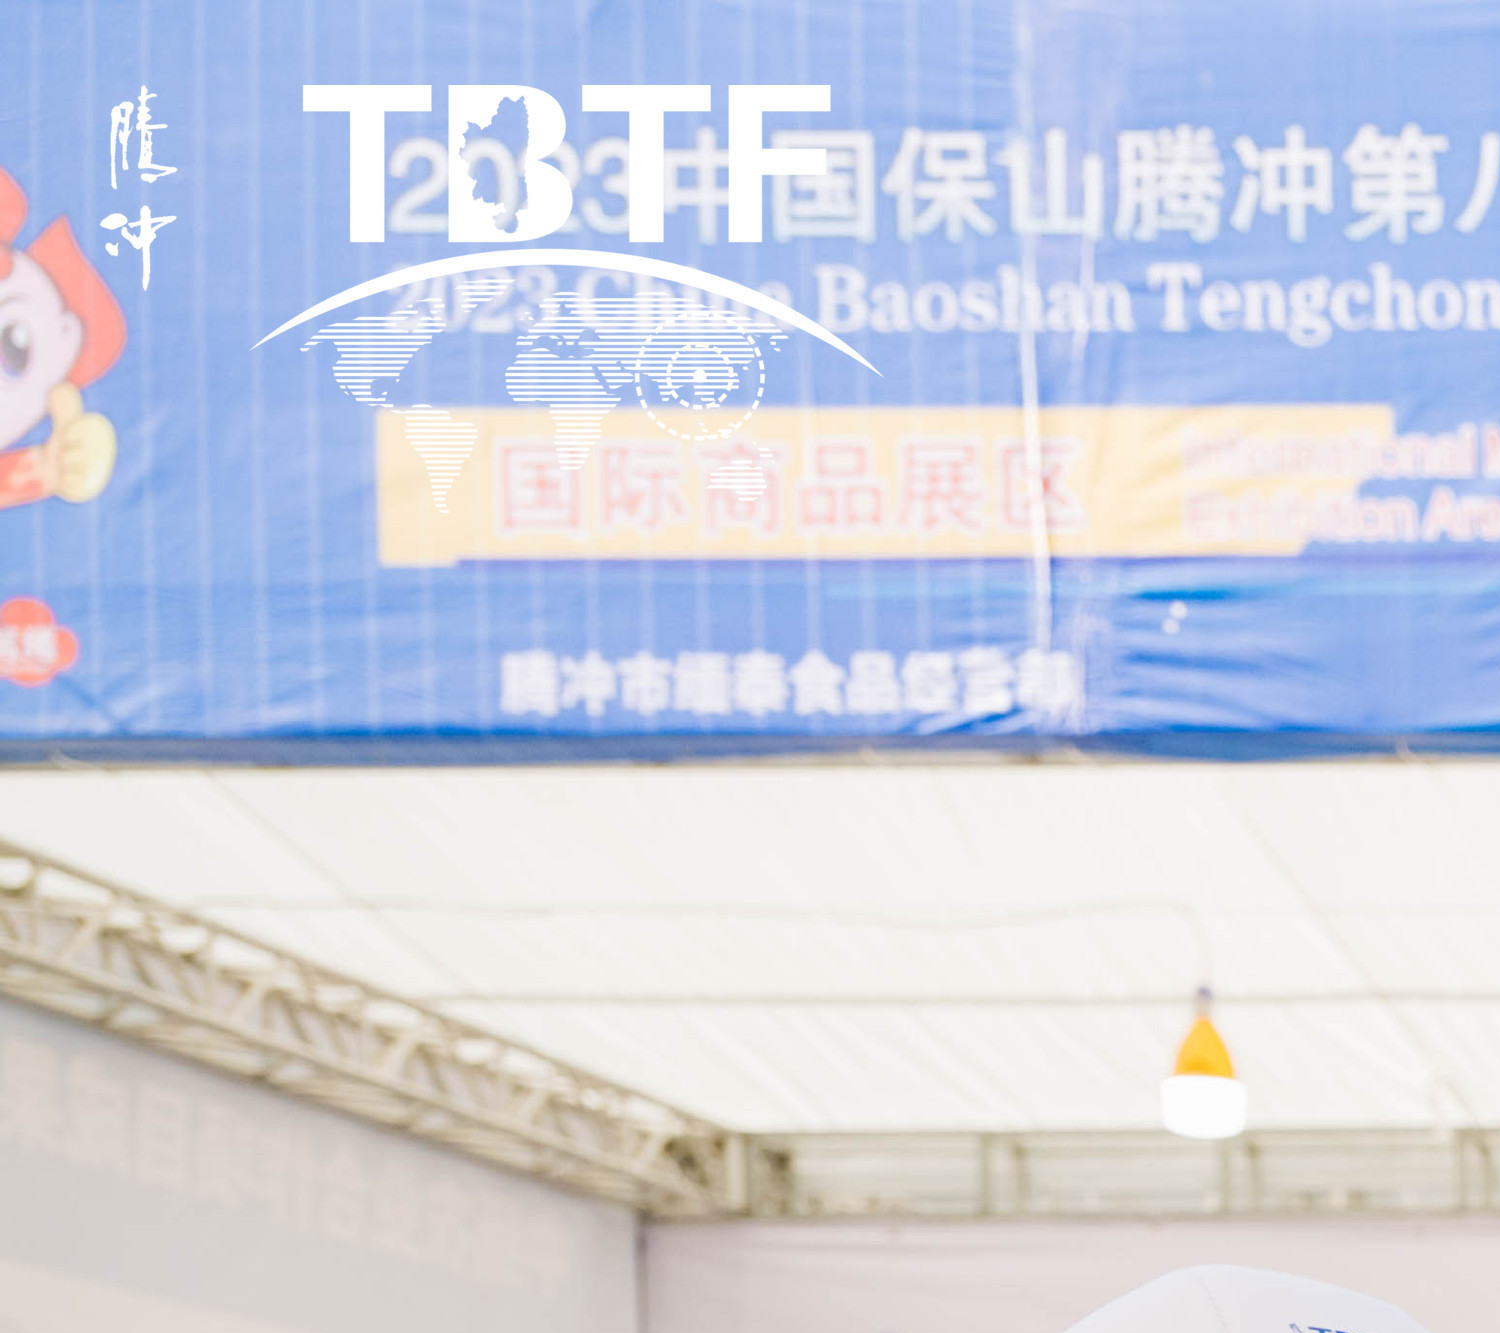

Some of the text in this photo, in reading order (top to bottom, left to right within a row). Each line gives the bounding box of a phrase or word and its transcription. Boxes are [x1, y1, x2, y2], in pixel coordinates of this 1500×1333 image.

[814, 261, 1137, 334] Baoshan
[496, 438, 1086, 536] 国际商品展区
